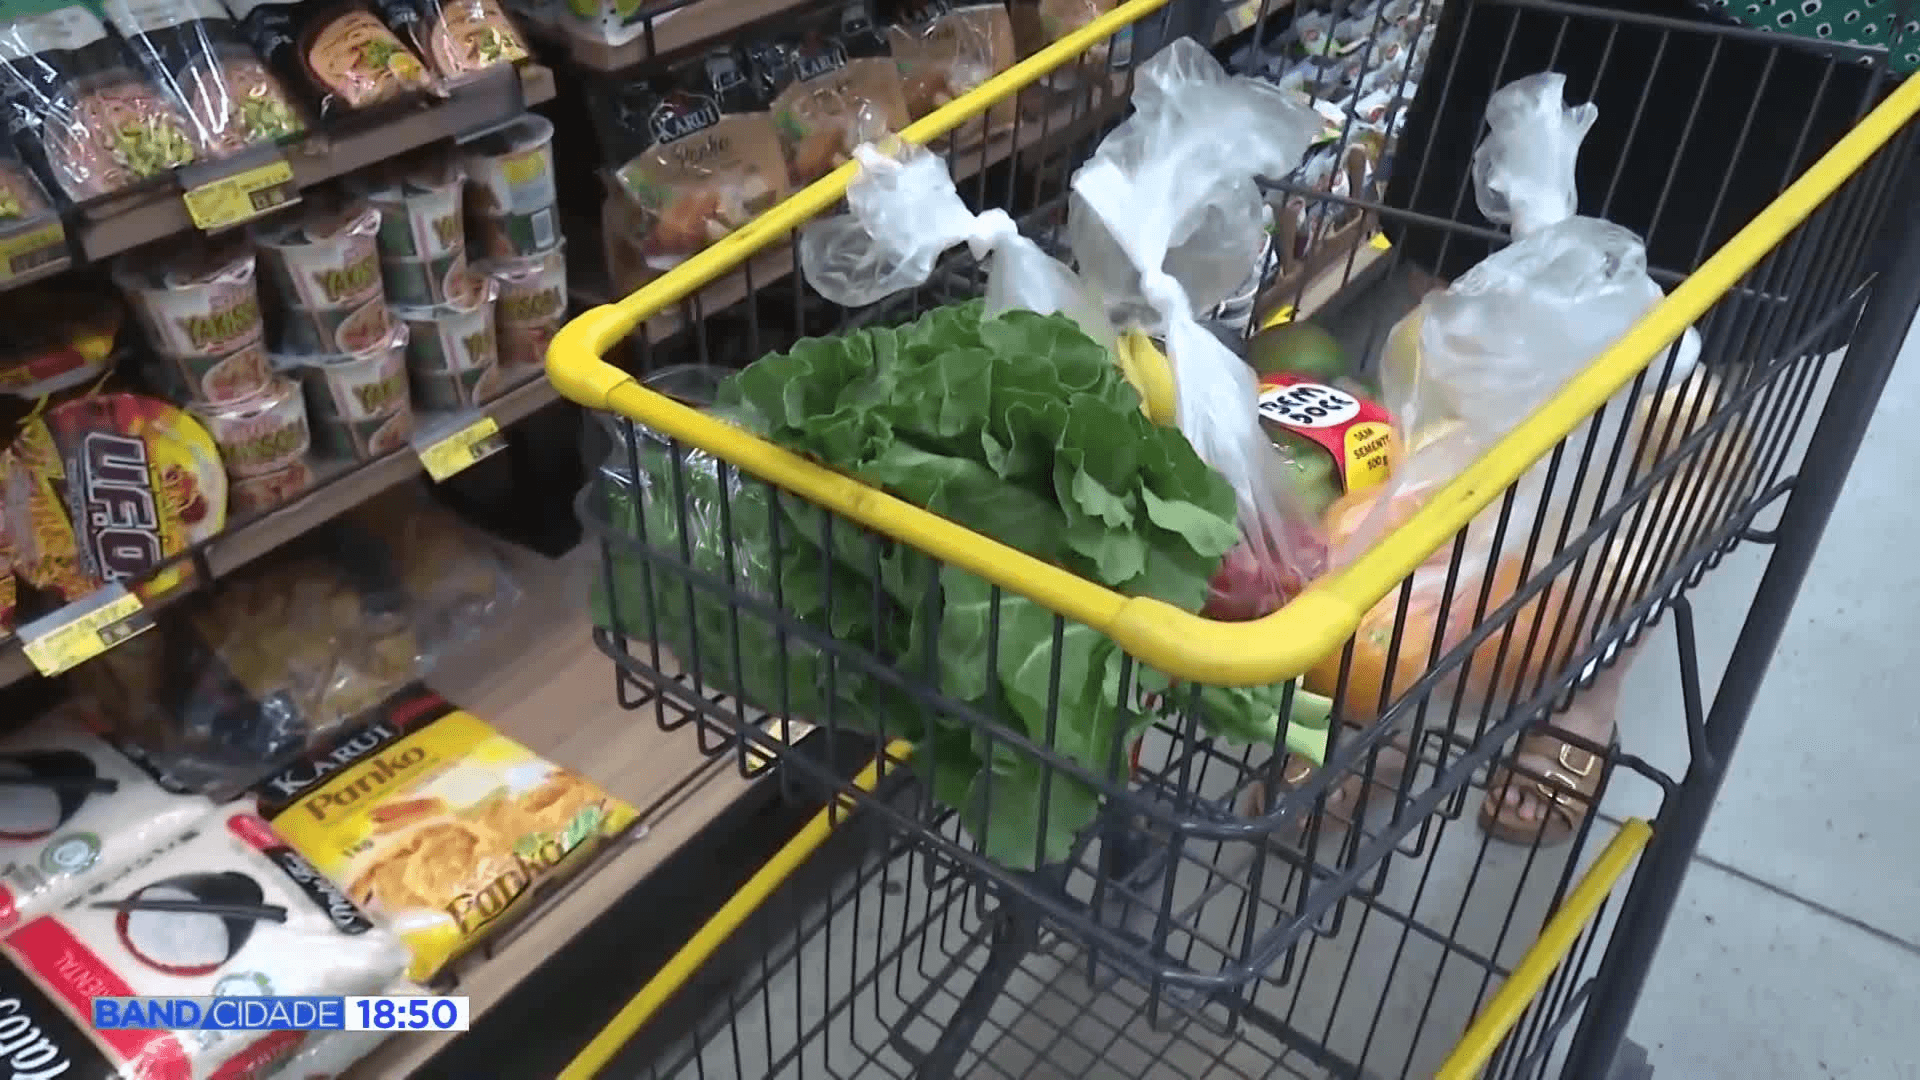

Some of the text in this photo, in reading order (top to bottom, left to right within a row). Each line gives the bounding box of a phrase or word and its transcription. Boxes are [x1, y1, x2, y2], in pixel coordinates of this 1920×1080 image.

[656, 104, 718, 139] KARUI
[271, 725, 394, 796] KARUI
[305, 747, 425, 831] Panko
[445, 840, 563, 937] Panko
